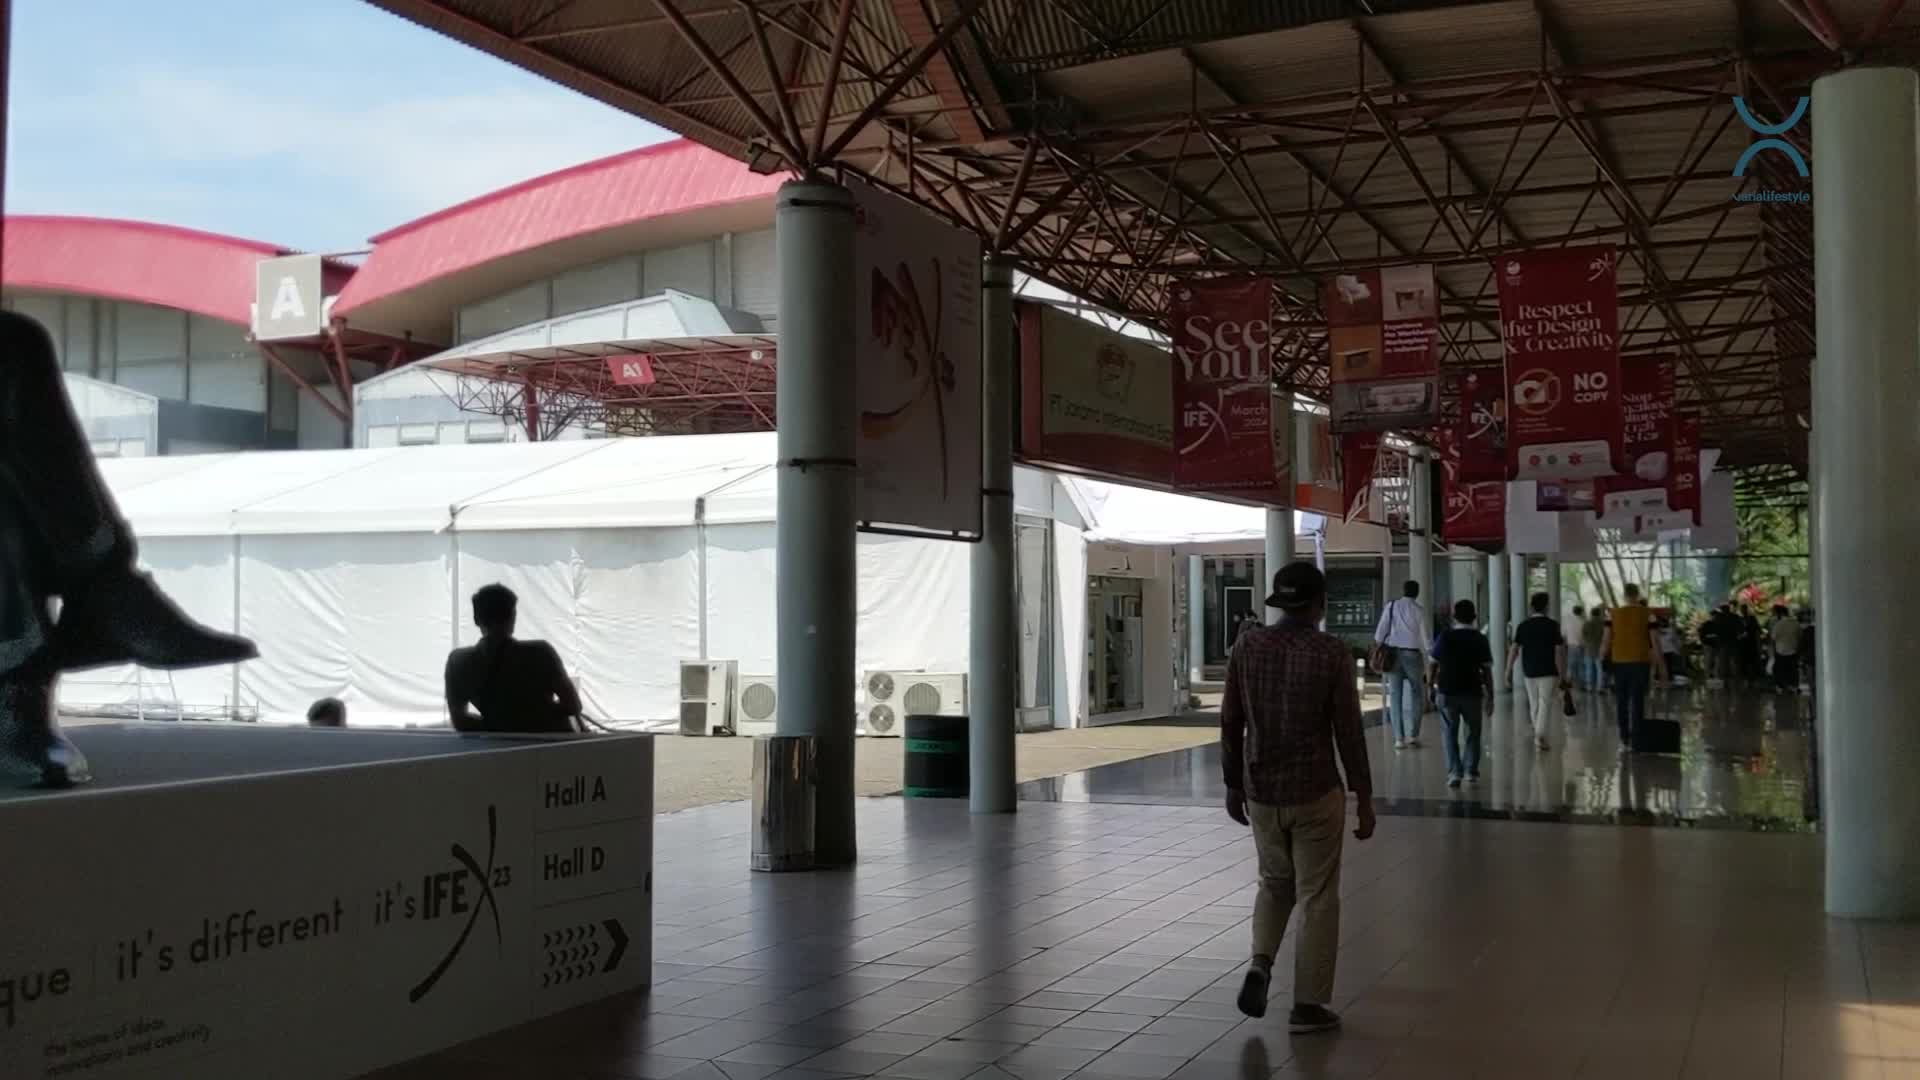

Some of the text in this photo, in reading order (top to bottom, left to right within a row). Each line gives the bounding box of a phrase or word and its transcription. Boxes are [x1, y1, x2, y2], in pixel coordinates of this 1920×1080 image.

[271, 276, 306, 318] A
[1519, 300, 1593, 320] Respect
[1185, 315, 1270, 353] See
[1504, 316, 1602, 338] the Design
[1505, 331, 1614, 355] & Creativity
[622, 360, 643, 378] A1
[1572, 371, 1608, 391] NO
[1574, 391, 1608, 403] COPY
[544, 775, 607, 809] Hall A
[544, 846, 606, 880] Hall D
[117, 928, 174, 981] it's
[190, 898, 343, 963] different
[375, 882, 416, 926] it's
